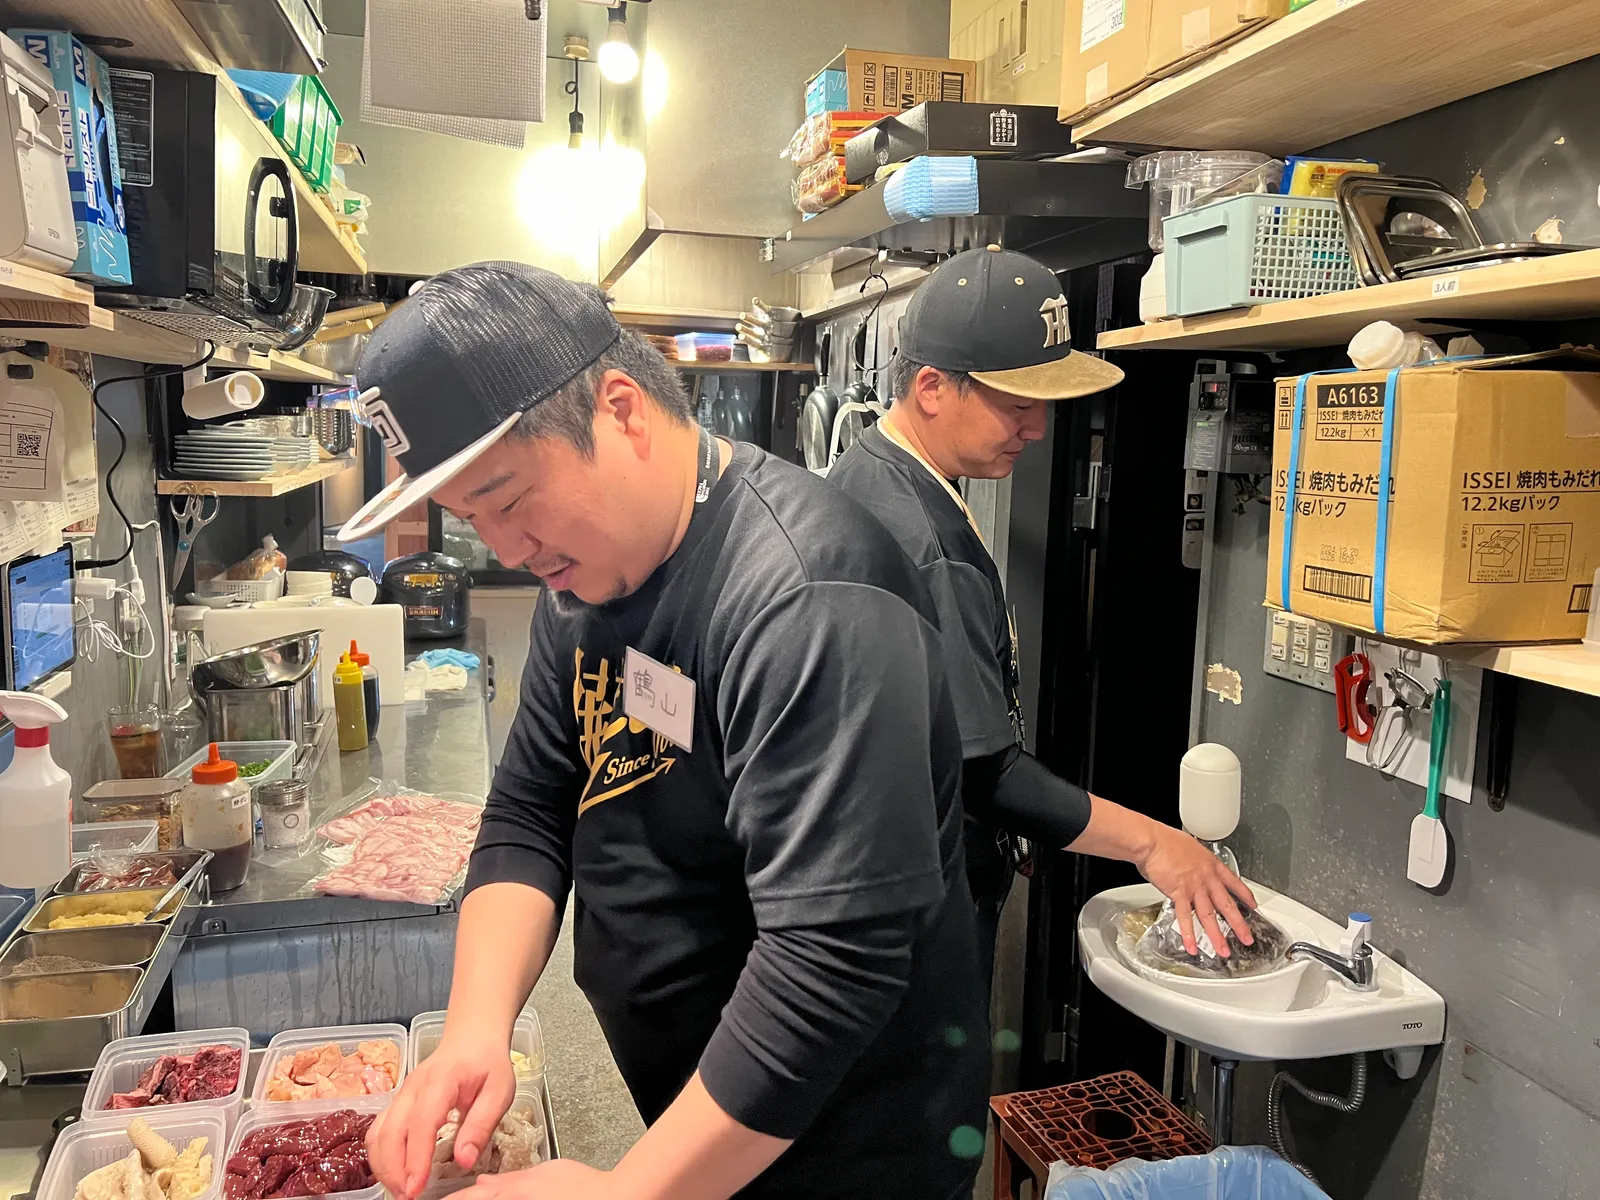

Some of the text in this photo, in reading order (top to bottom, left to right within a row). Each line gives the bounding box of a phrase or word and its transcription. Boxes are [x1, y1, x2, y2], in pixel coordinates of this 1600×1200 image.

[73, 46, 85, 82] M
[1327, 386, 1379, 405] A6163
[1320, 410, 1338, 421] ISSEI
[1321, 428, 1347, 438] 12.2kg
[1275, 470, 1306, 489] ISEI
[1463, 469, 1600, 489] ISSEI 焼肉もみだれ
[1275, 496, 1347, 518] 12kgパック
[1461, 494, 1560, 512] 12.2kgパック
[603, 754, 651, 785] Since
[1401, 1021, 1423, 1030] TOTO
